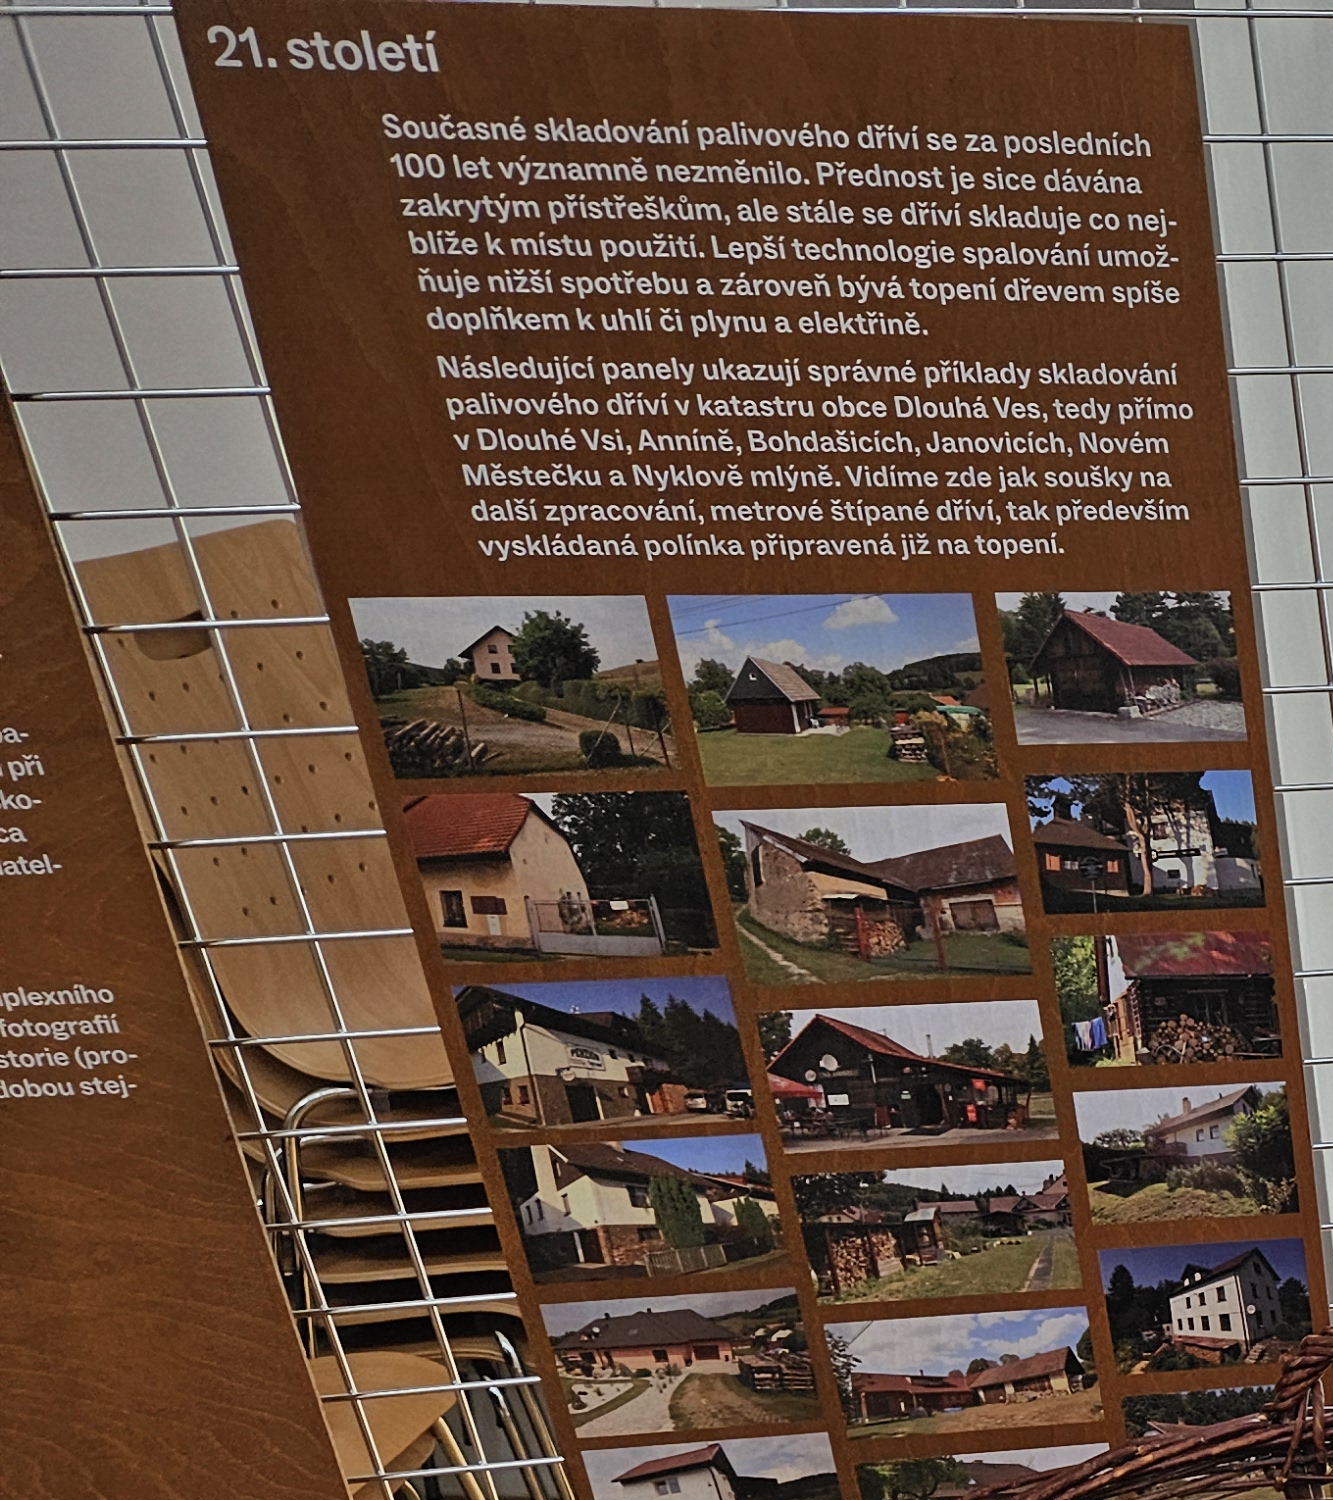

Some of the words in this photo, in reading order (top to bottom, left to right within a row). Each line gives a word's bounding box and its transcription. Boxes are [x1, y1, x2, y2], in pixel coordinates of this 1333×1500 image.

[208, 26, 277, 67] 21.
[287, 30, 439, 72] století
[382, 114, 526, 141] Současné
[535, 118, 689, 144] skladování
[697, 122, 849, 150] palivového
[858, 125, 918, 150] dříví
[927, 133, 957, 151] se
[965, 135, 998, 152] za
[1004, 131, 1151, 158] posledních
[400, 193, 540, 223] zakrytým
[548, 194, 730, 225] přístřeškům,
[737, 199, 778, 222] ale
[787, 199, 854, 223] stále
[863, 208, 892, 224] se
[901, 202, 961, 226] dříví
[969, 204, 1081, 235] skladuje
[1089, 214, 1119, 230] co
[1128, 209, 1177, 237] nej-
[418, 268, 480, 298] ňuje
[488, 269, 553, 293] nižší
[561, 271, 688, 299] spotřebu
[696, 279, 714, 295] a
[720, 272, 831, 296] zároveň
[838, 275, 905, 303] bývá
[909, 278, 996, 305] topení
[1004, 278, 1104, 302] dřevem
[1112, 281, 1179, 308] spíše
[437, 355, 594, 384] Následující
[602, 357, 694, 385] panely
[702, 358, 800, 386] ukazují
[808, 359, 916, 387] správné
[924, 360, 1030, 389] příklady
[1039, 363, 1176, 384] skladování
[446, 392, 598, 420] palivového
[607, 392, 668, 415] dříví
[674, 400, 689, 415] v
[697, 394, 814, 417] katastru
[822, 396, 886, 417] obce
[894, 396, 989, 418] Dlouhá
[993, 397, 1048, 422] Ves,
[1053, 398, 1110, 424] tedy
[1119, 397, 1193, 424] přímo
[454, 435, 469, 450] v
[477, 428, 576, 450] Dlouhé
[581, 429, 632, 455] Vsi,
[639, 429, 741, 456] Anníně,
[748, 430, 920, 456] Bohdašicích,
[926, 432, 1072, 457] Janovicích,
[1079, 432, 1169, 453] Novém
[7, 754, 45, 781] při
[0, 854, 62, 876] atel-
[0, 984, 114, 1011] plexního
[74, 1046, 138, 1069] (pro-
[79, 1074, 137, 1098] stej-
